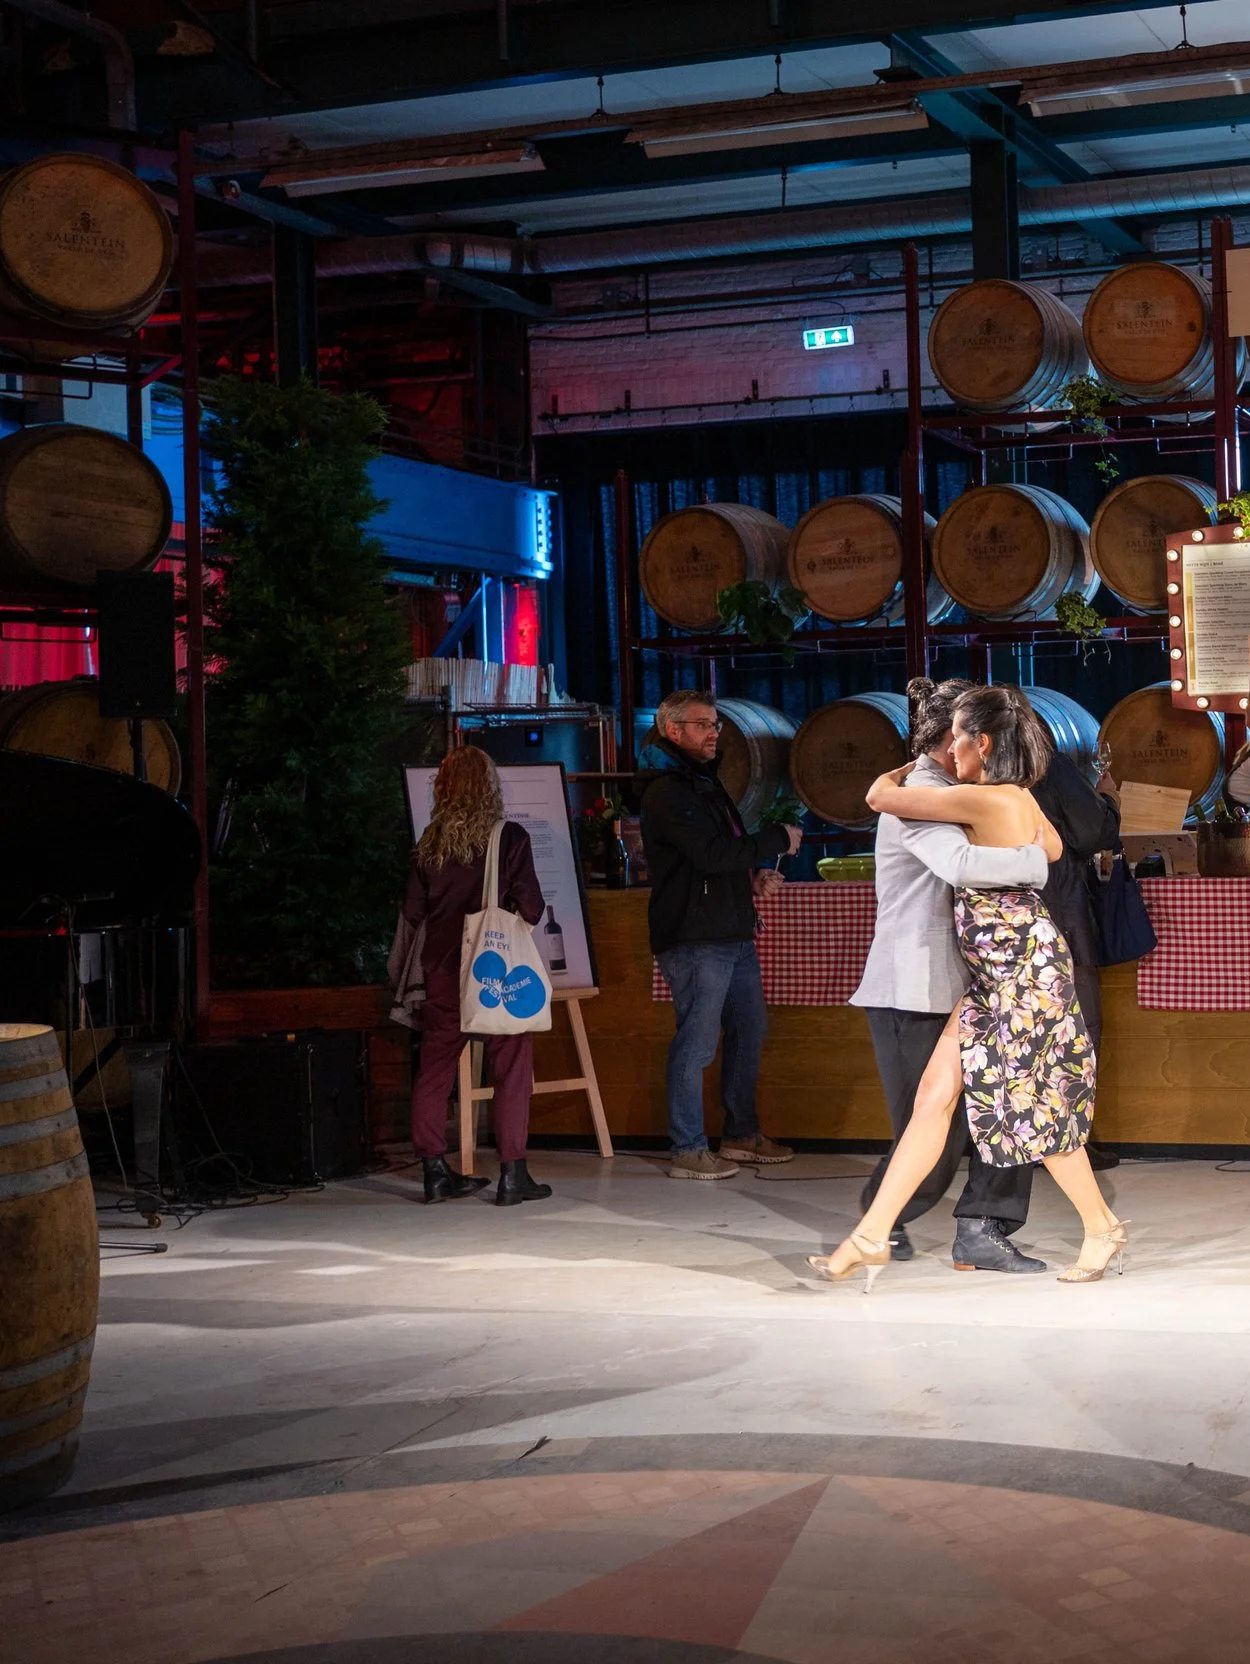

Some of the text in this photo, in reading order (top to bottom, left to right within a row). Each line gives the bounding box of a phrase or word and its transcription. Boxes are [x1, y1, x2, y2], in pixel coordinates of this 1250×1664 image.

[45, 231, 126, 249] SALENTEIN
[1115, 319, 1174, 330] SALENTEIN
[961, 335, 1015, 346] SALENTEIN
[1131, 749, 1188, 758] SALENTEIN
[484, 931, 505, 939] KEEP
[484, 940, 495, 948] AN
